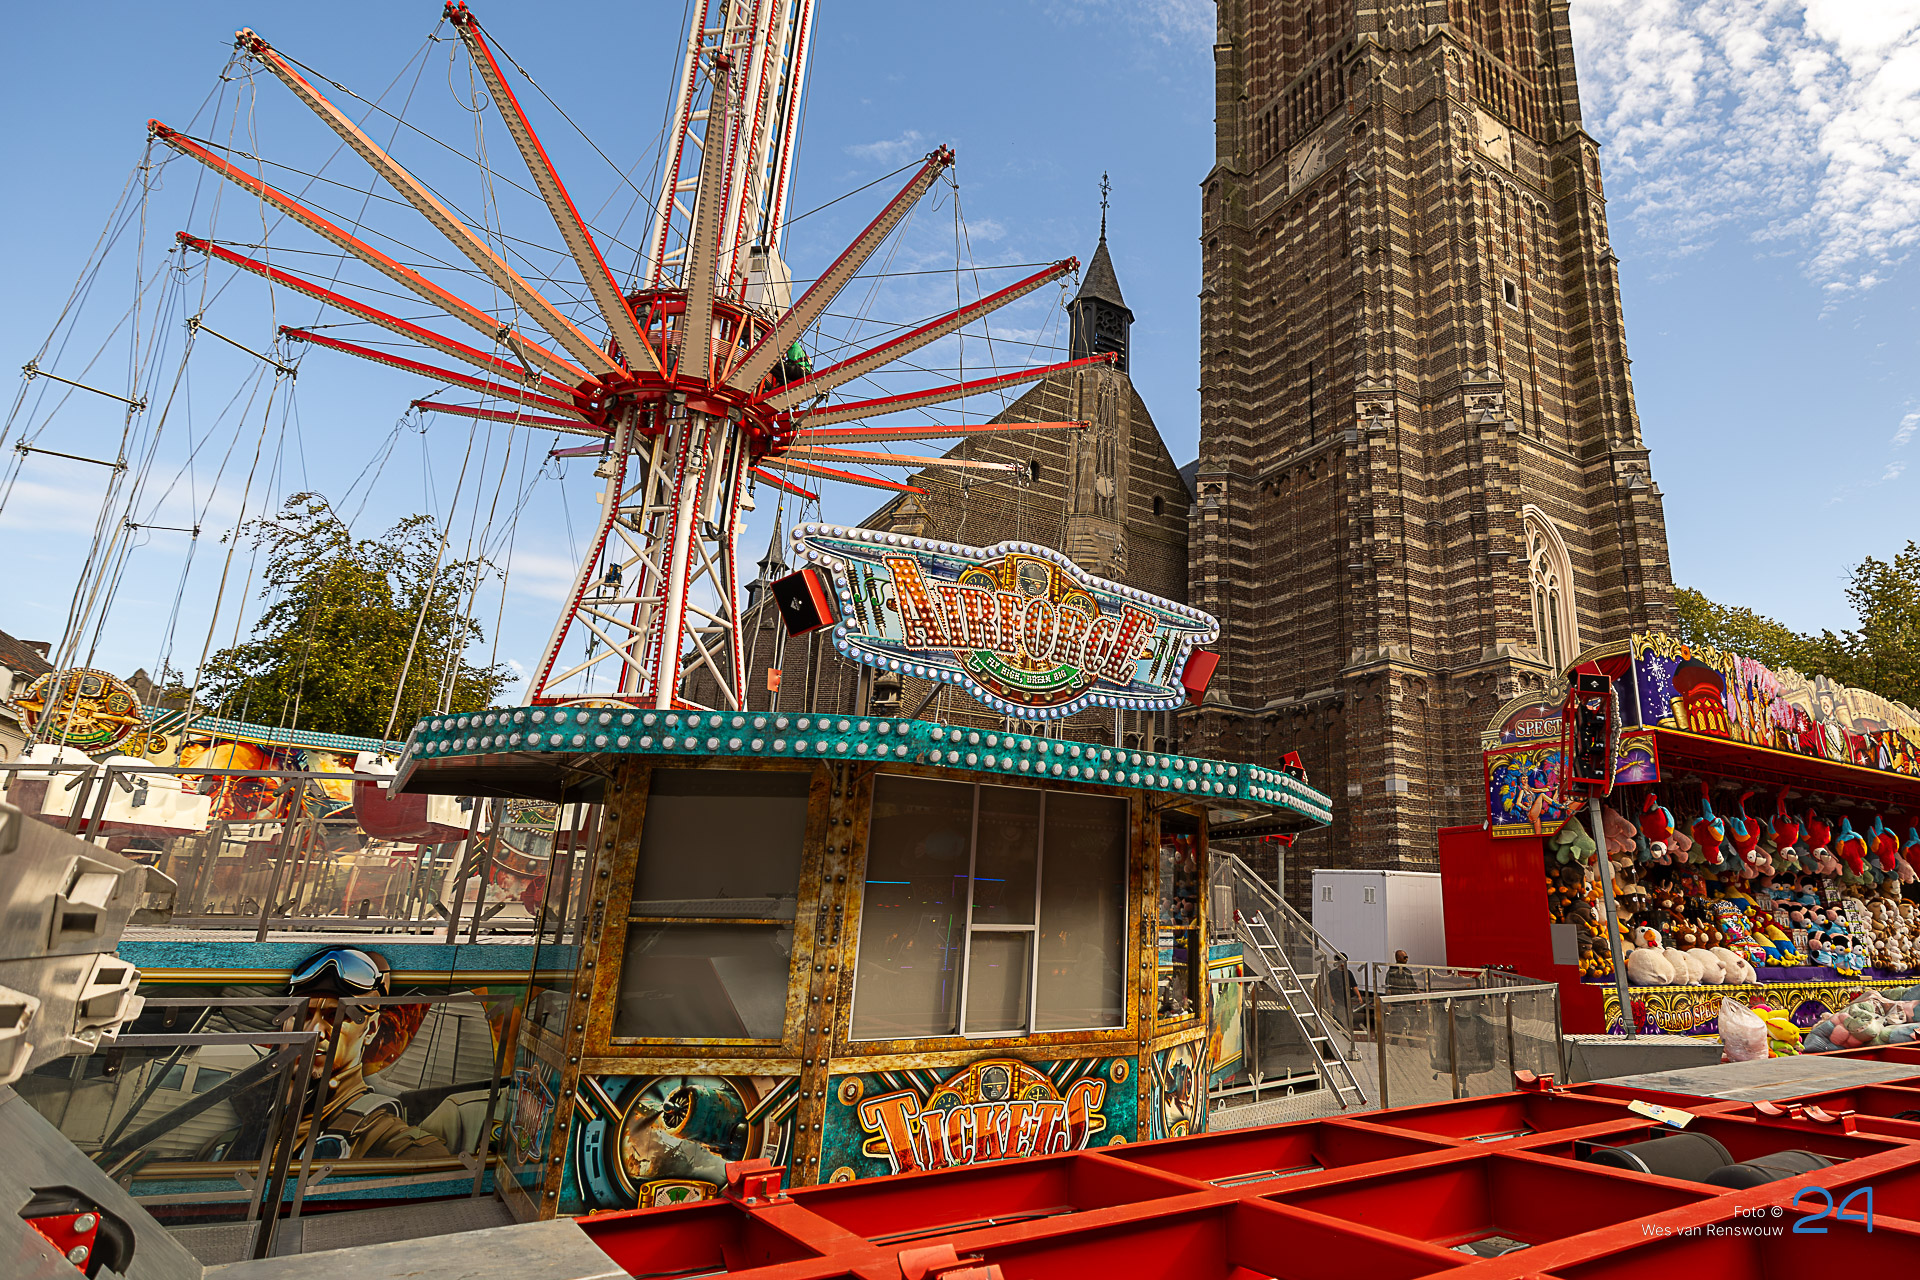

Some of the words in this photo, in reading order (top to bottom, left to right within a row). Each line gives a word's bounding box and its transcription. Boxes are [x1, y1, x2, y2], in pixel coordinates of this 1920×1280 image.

[883, 554, 1159, 685] AIRFORCE
[985, 656, 1000, 669] FLY
[1053, 669, 1067, 682] BIG
[1655, 1009, 1692, 1030] GRAND
[860, 1079, 1107, 1176] TICKETS
